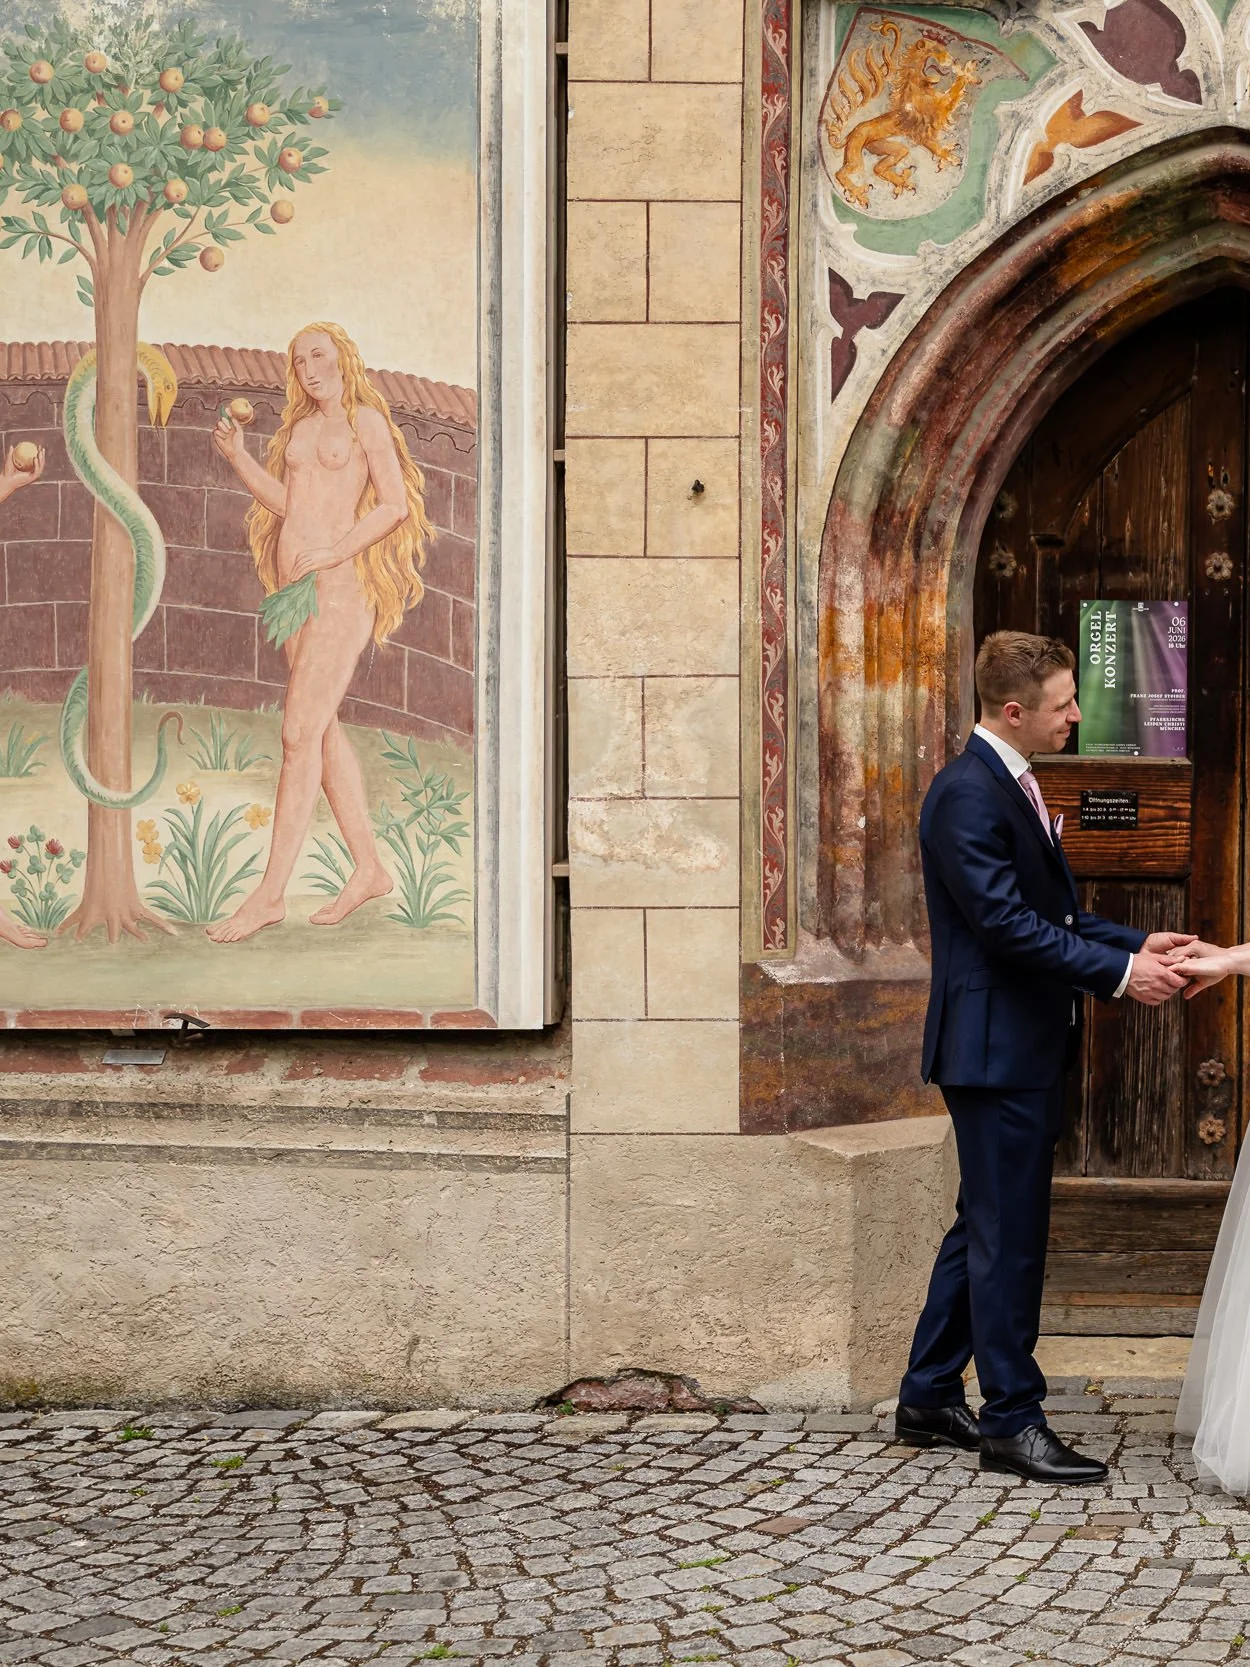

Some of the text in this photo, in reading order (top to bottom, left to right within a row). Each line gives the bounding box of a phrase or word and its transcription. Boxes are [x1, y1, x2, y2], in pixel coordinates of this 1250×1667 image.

[1090, 611, 1102, 665] ORGEL
[1171, 616, 1186, 627] 06
[1105, 611, 1117, 689] KONZERT
